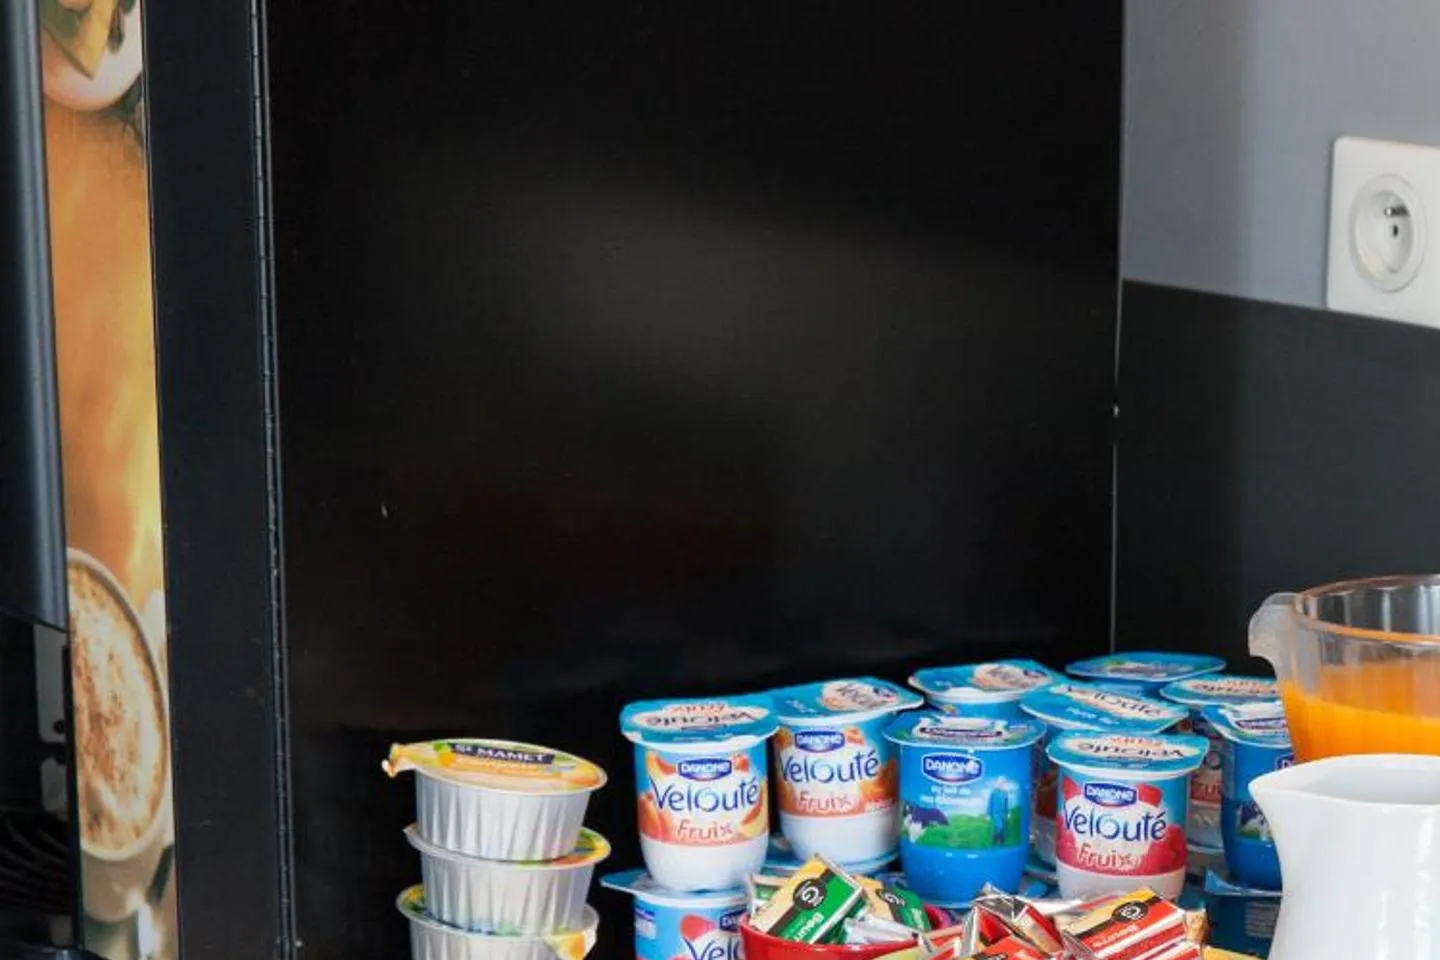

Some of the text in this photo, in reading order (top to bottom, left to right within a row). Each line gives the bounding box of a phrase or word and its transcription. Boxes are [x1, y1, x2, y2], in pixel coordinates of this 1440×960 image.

[477, 747, 545, 762] MAMET
[780, 747, 878, 784] Velouté
[649, 775, 758, 812] Velouté
[677, 818, 734, 839] Fruix
[1063, 801, 1166, 842] Velouté
